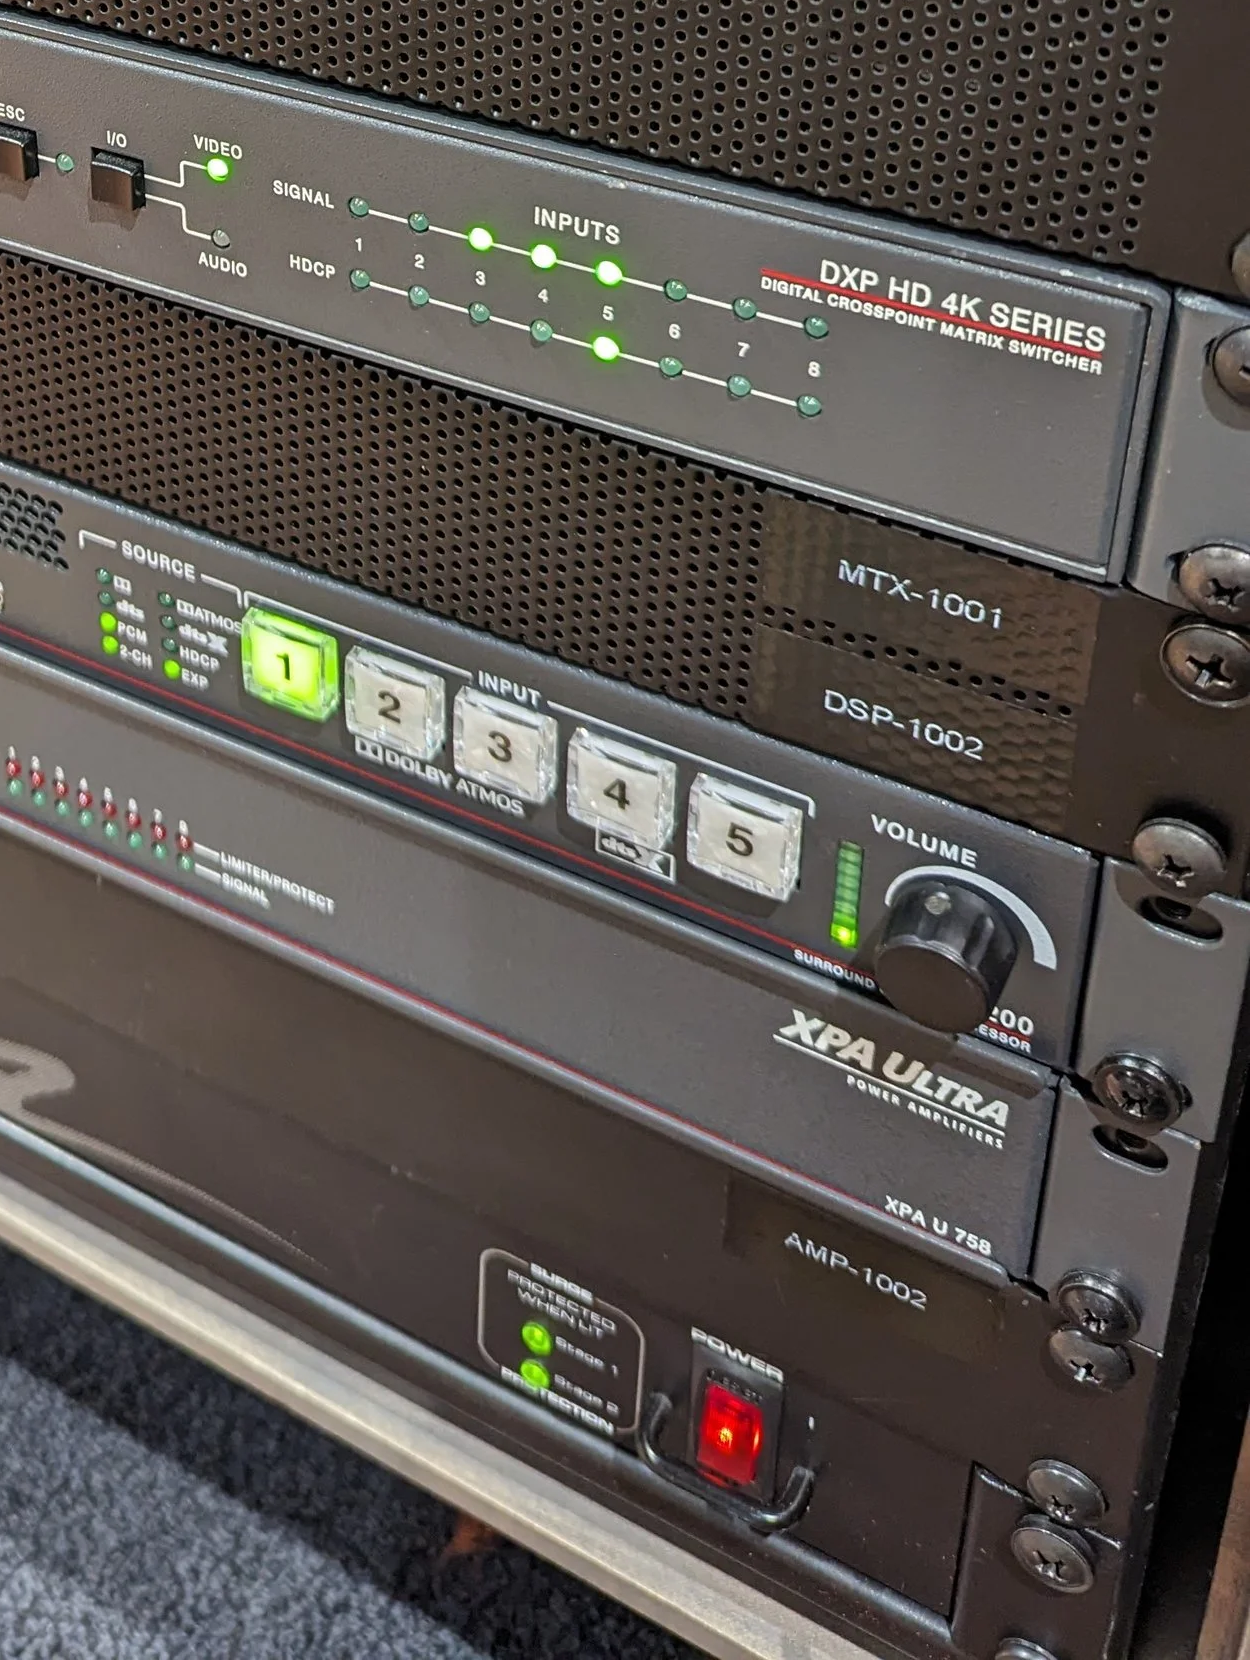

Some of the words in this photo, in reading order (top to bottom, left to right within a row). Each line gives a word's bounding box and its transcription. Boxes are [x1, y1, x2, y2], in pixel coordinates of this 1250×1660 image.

[106, 130, 127, 148] I/O
[193, 134, 242, 160] VIDEO
[272, 180, 335, 209] SIGNAL
[533, 206, 621, 244] INPUTS
[355, 238, 363, 252] 1
[414, 253, 425, 270] 2
[198, 251, 248, 278] AUDIO
[289, 254, 336, 279] HDCP
[475, 271, 486, 286] 3
[538, 288, 549, 304] 4
[820, 259, 880, 293] DXP
[888, 276, 932, 309] HD
[941, 293, 983, 323] 4K
[989, 303, 1106, 353] SERIES
[602, 306, 614, 321] 5
[760, 276, 824, 304] DIGITAL
[826, 294, 937, 333] CROSSPOINT
[939, 323, 1004, 351] MATRIX
[1008, 339, 1103, 376] SWITCHER
[668, 324, 681, 340] 6
[737, 341, 750, 358] 7
[807, 361, 821, 378] 8
[120, 539, 196, 583] SOURCE
[838, 560, 1003, 629] MTX-1001
[117, 620, 148, 648] PCM
[192, 606, 242, 638] ATMOS
[119, 644, 153, 671] 2-CH
[179, 645, 220, 675] HDCP
[276, 652, 291, 681] 1
[181, 667, 209, 692] EXP
[477, 671, 541, 708] INPUT
[377, 690, 401, 724] 2
[824, 689, 984, 761] DSP-1002
[488, 731, 512, 763] 3
[385, 750, 451, 792] DOLBY
[456, 778, 525, 819] ATMOS
[603, 778, 630, 810] 4
[726, 822, 753, 857] 5
[871, 814, 978, 869] VOLUME
[220, 851, 335, 914] LIMITER/PROTECT
[222, 871, 270, 909] SIGNAL
[793, 948, 876, 990] SURROUND
[778, 1008, 875, 1074] XPA
[881, 1051, 1010, 1128] ULTRA
[846, 1074, 901, 1107] POWER
[907, 1101, 1004, 1151] AMPLIFIERS
[884, 1194, 926, 1228] XPA
[932, 1215, 949, 1237] U
[953, 1226, 993, 1257] 758
[530, 1262, 594, 1305] SURGE
[784, 1232, 928, 1313] AMP-1002
[507, 1268, 617, 1336] PROTECTED
[517, 1287, 577, 1330] WHEN
[578, 1318, 603, 1340] LIT
[555, 1336, 605, 1371] Stage
[691, 1326, 784, 1384] POWER
